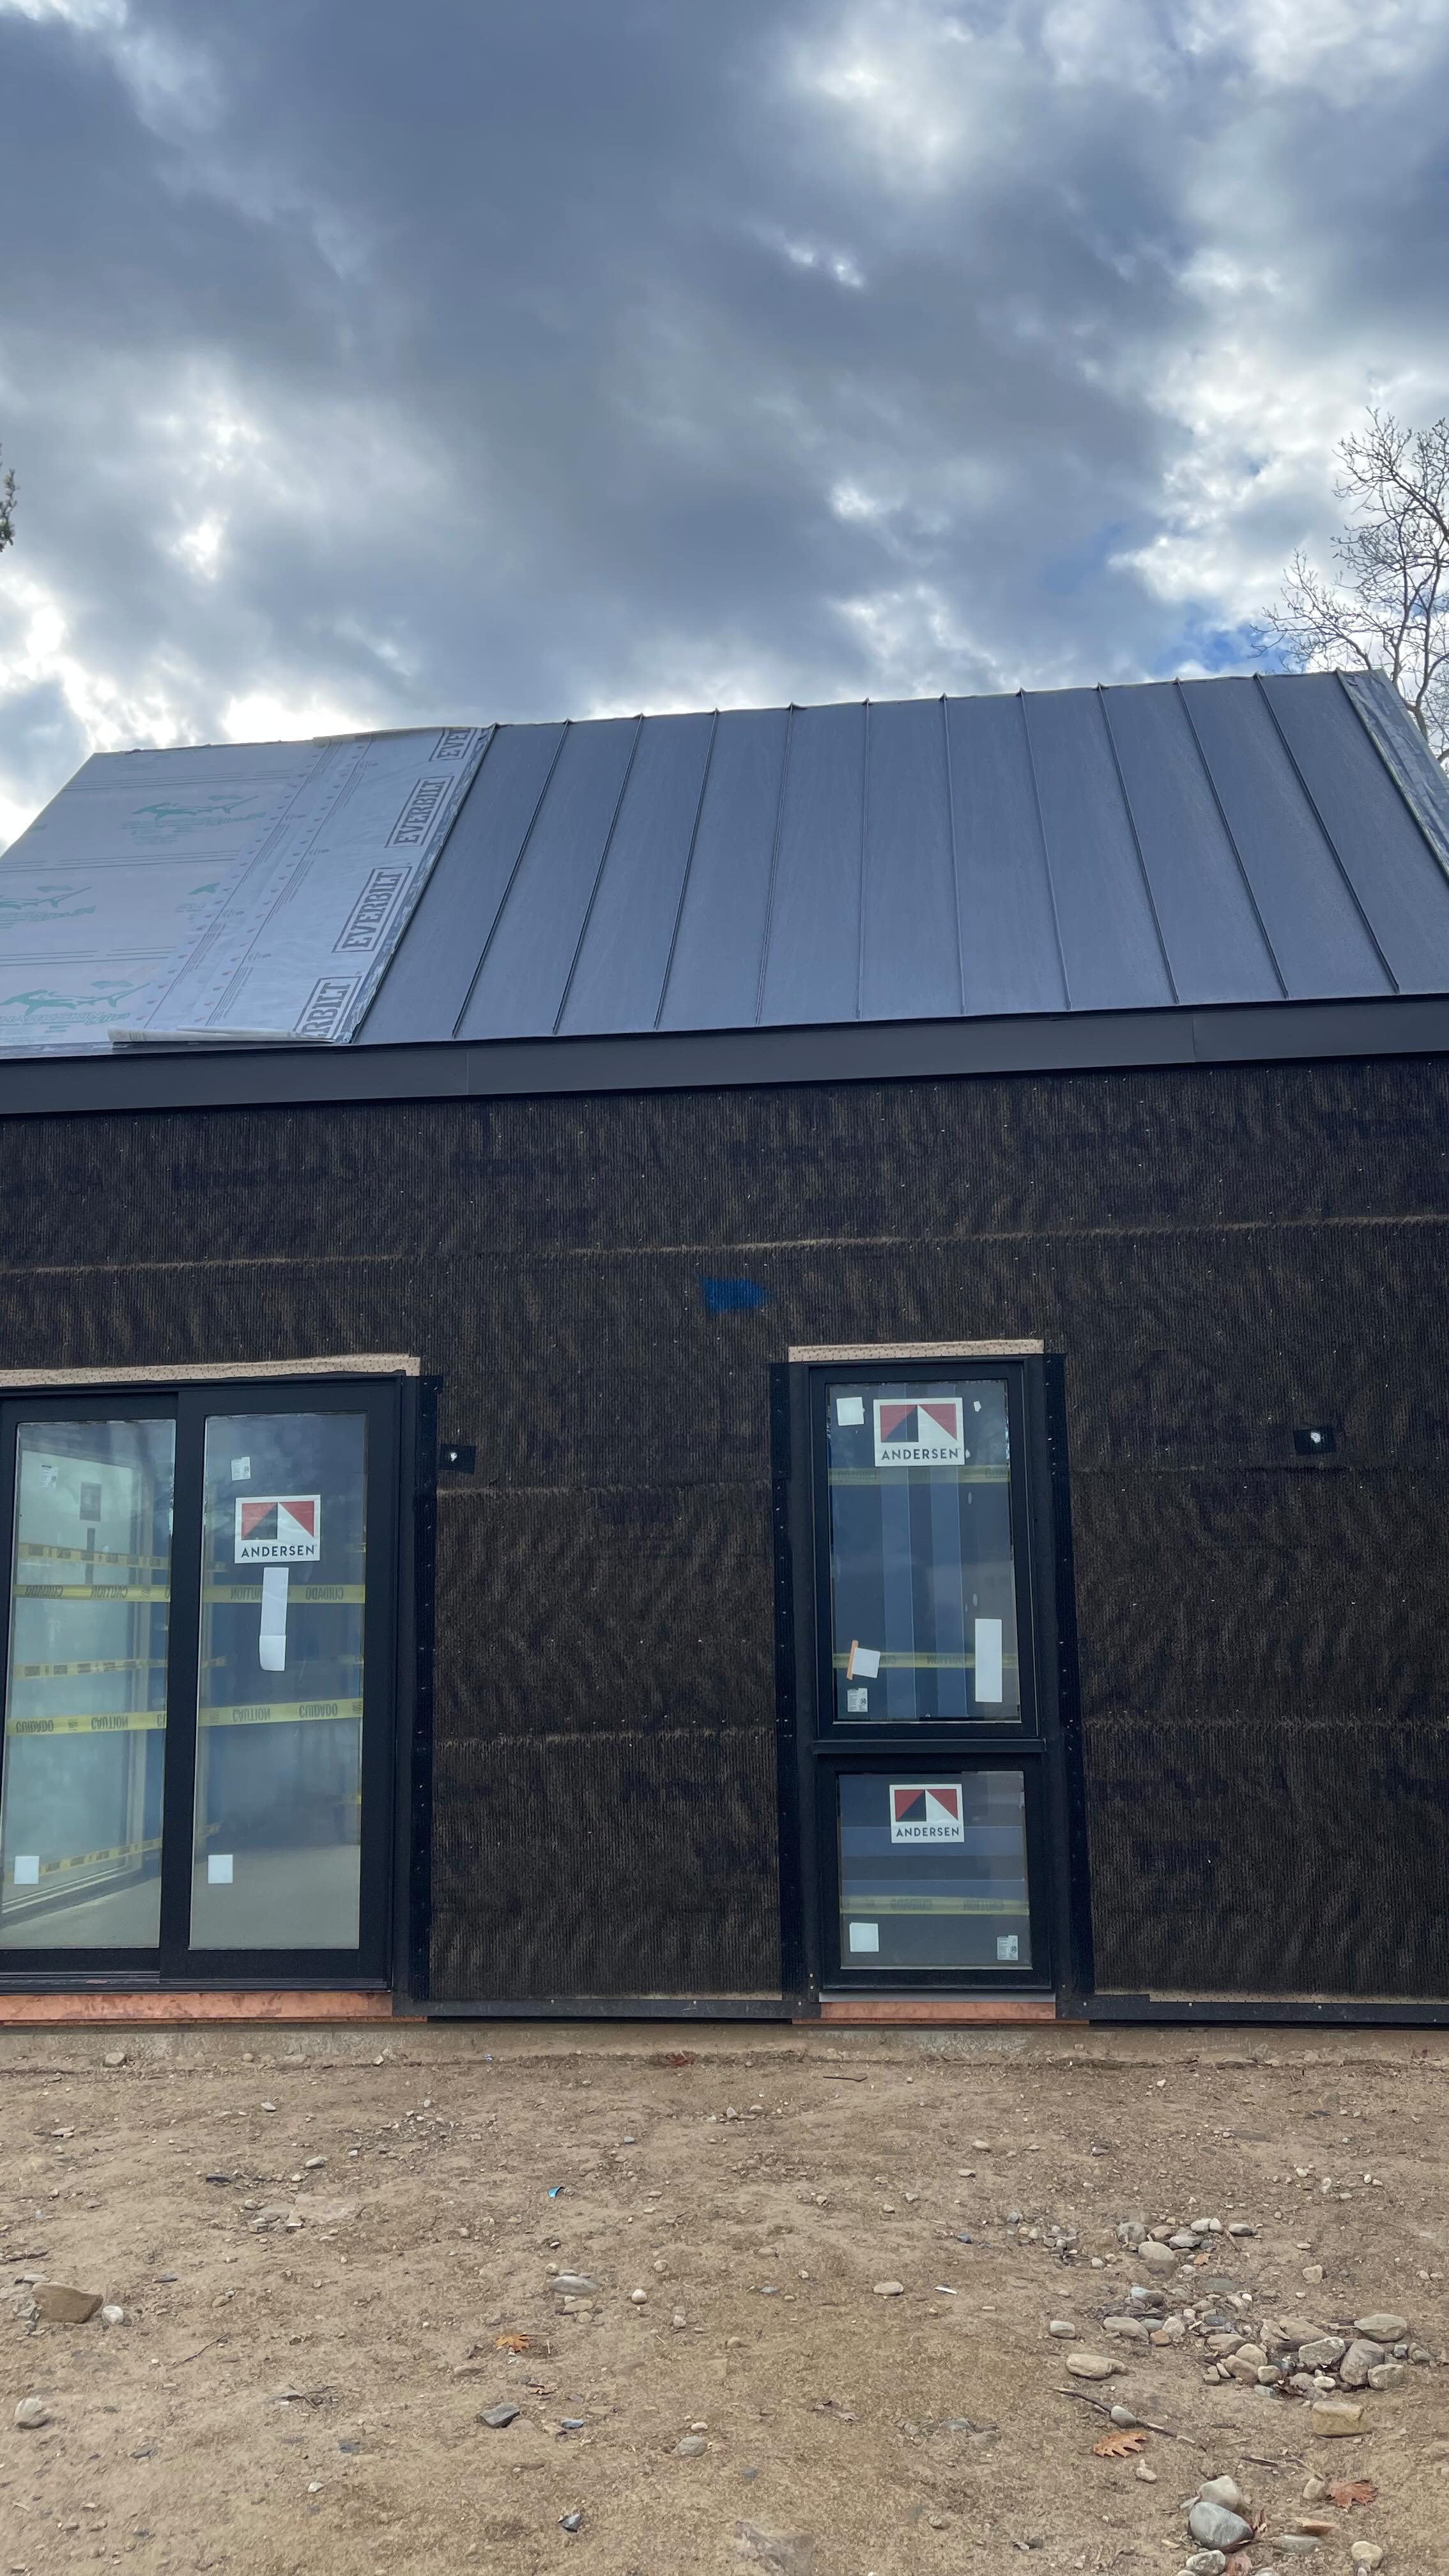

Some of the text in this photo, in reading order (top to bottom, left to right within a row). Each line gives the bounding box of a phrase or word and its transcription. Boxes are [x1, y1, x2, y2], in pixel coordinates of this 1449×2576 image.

[394, 781, 447, 845] EVERBILT
[341, 871, 404, 949] EVERBILT
[300, 982, 352, 1037] RBILT
[882, 1448, 959, 1460] ANDERSEN
[241, 1545, 315, 1558] ANDERSEN
[896, 1827, 960, 1837] ANDERSEN
